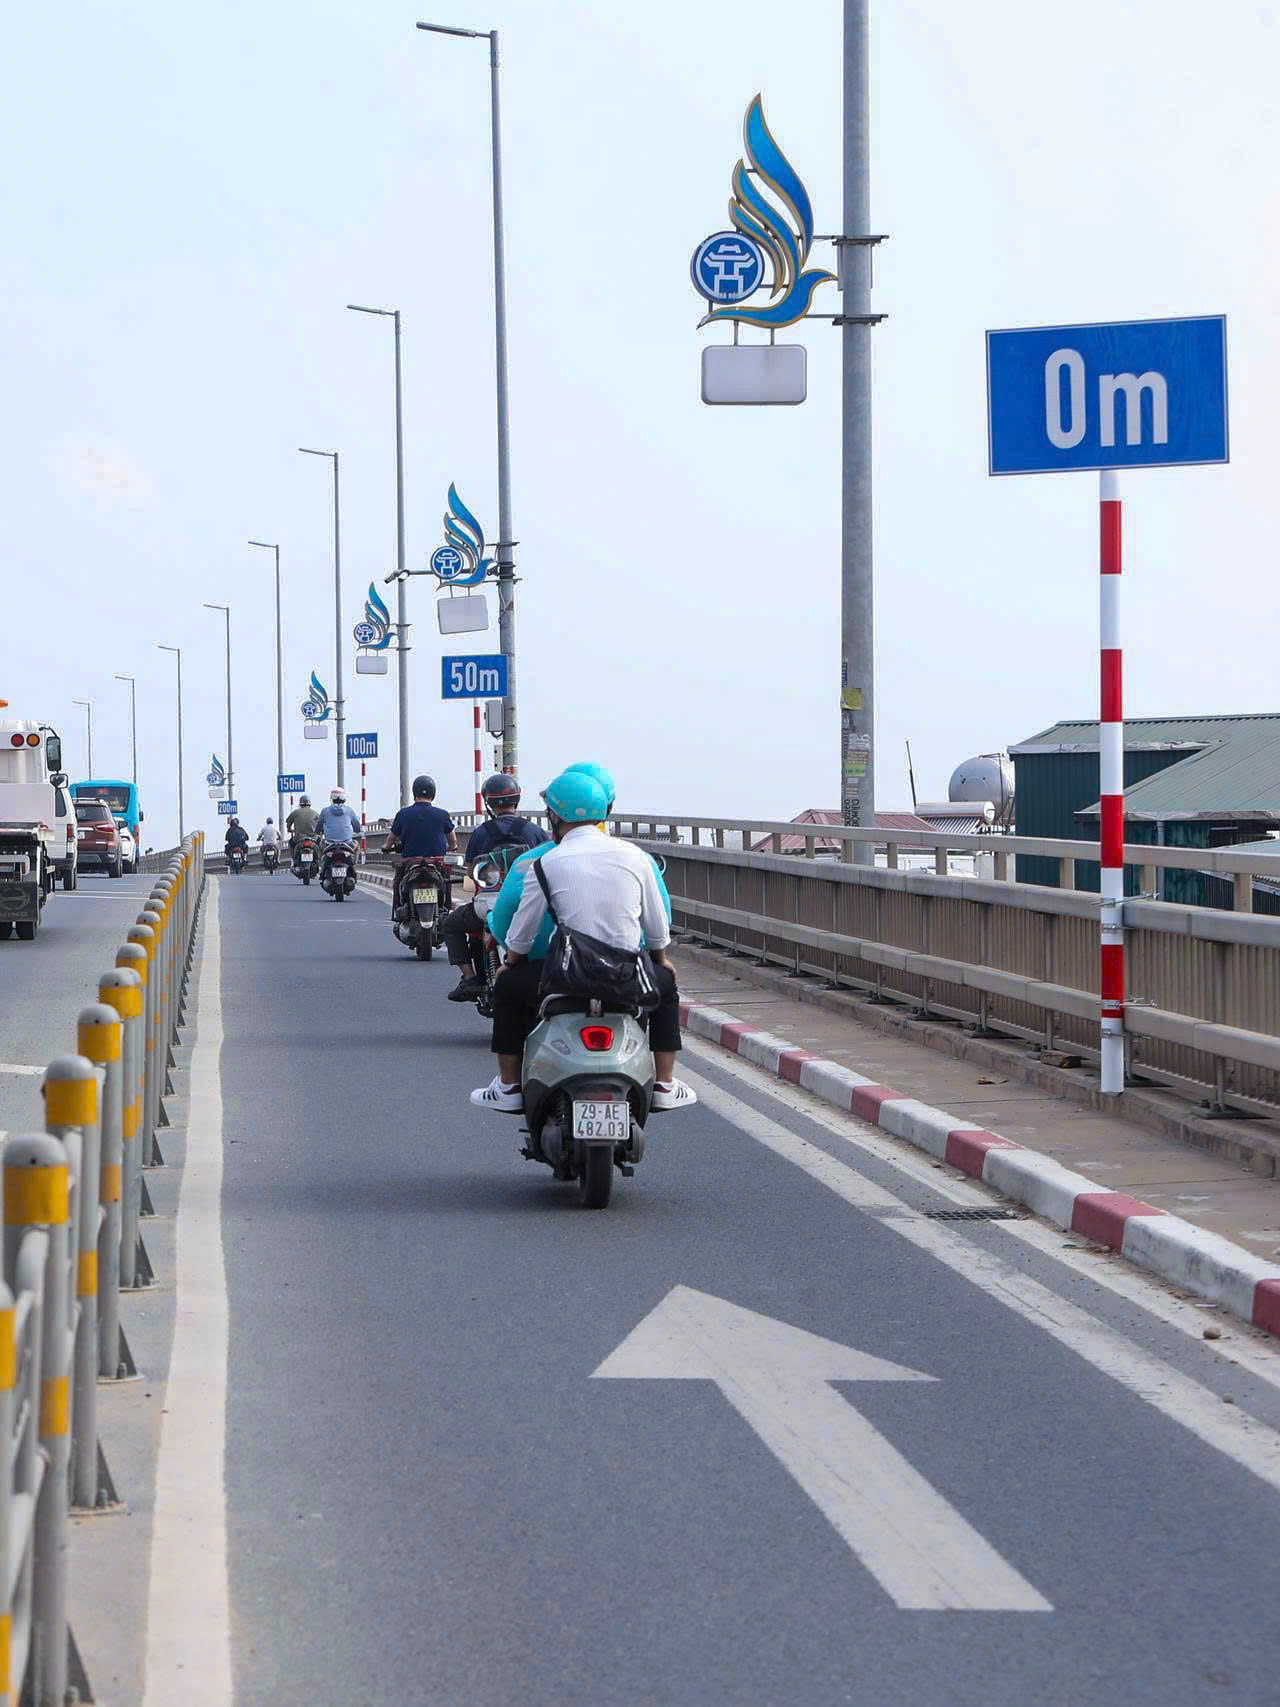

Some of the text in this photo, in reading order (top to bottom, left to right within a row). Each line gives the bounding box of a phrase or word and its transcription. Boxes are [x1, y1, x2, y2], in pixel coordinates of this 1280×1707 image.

[1045, 348, 1168, 449] 0m
[451, 661, 499, 692] 50m
[348, 737, 376, 756] 100m
[279, 777, 305, 791] 150m
[219, 802, 237, 814] 200m
[581, 1104, 620, 1120] 29-AE
[577, 1121, 625, 1137] 482.03
